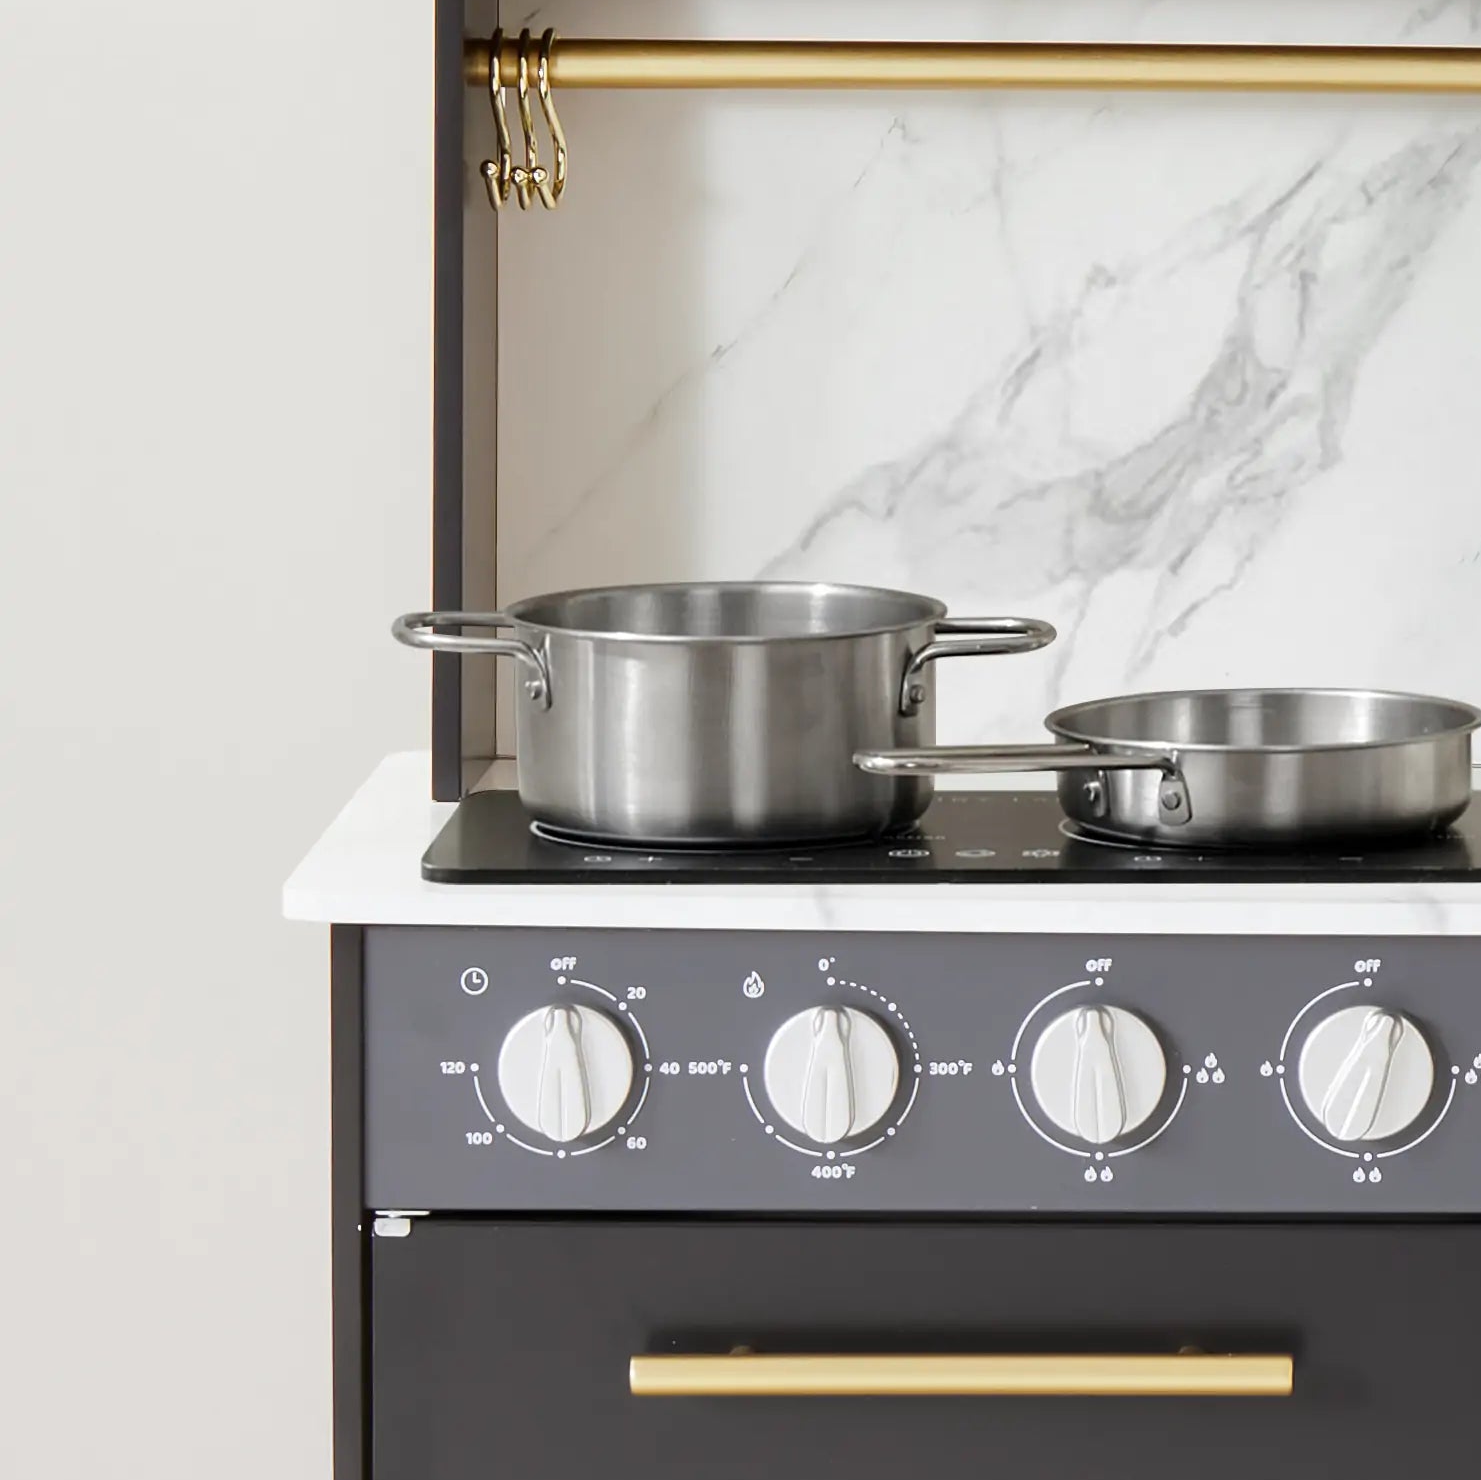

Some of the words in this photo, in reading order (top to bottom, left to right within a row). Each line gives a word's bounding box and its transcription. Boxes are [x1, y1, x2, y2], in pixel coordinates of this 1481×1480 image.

[626, 986, 647, 1000] 20
[439, 1061, 466, 1075] 120
[659, 1061, 681, 1075] 40
[465, 1131, 493, 1145] 100
[626, 1136, 647, 1150] 60
